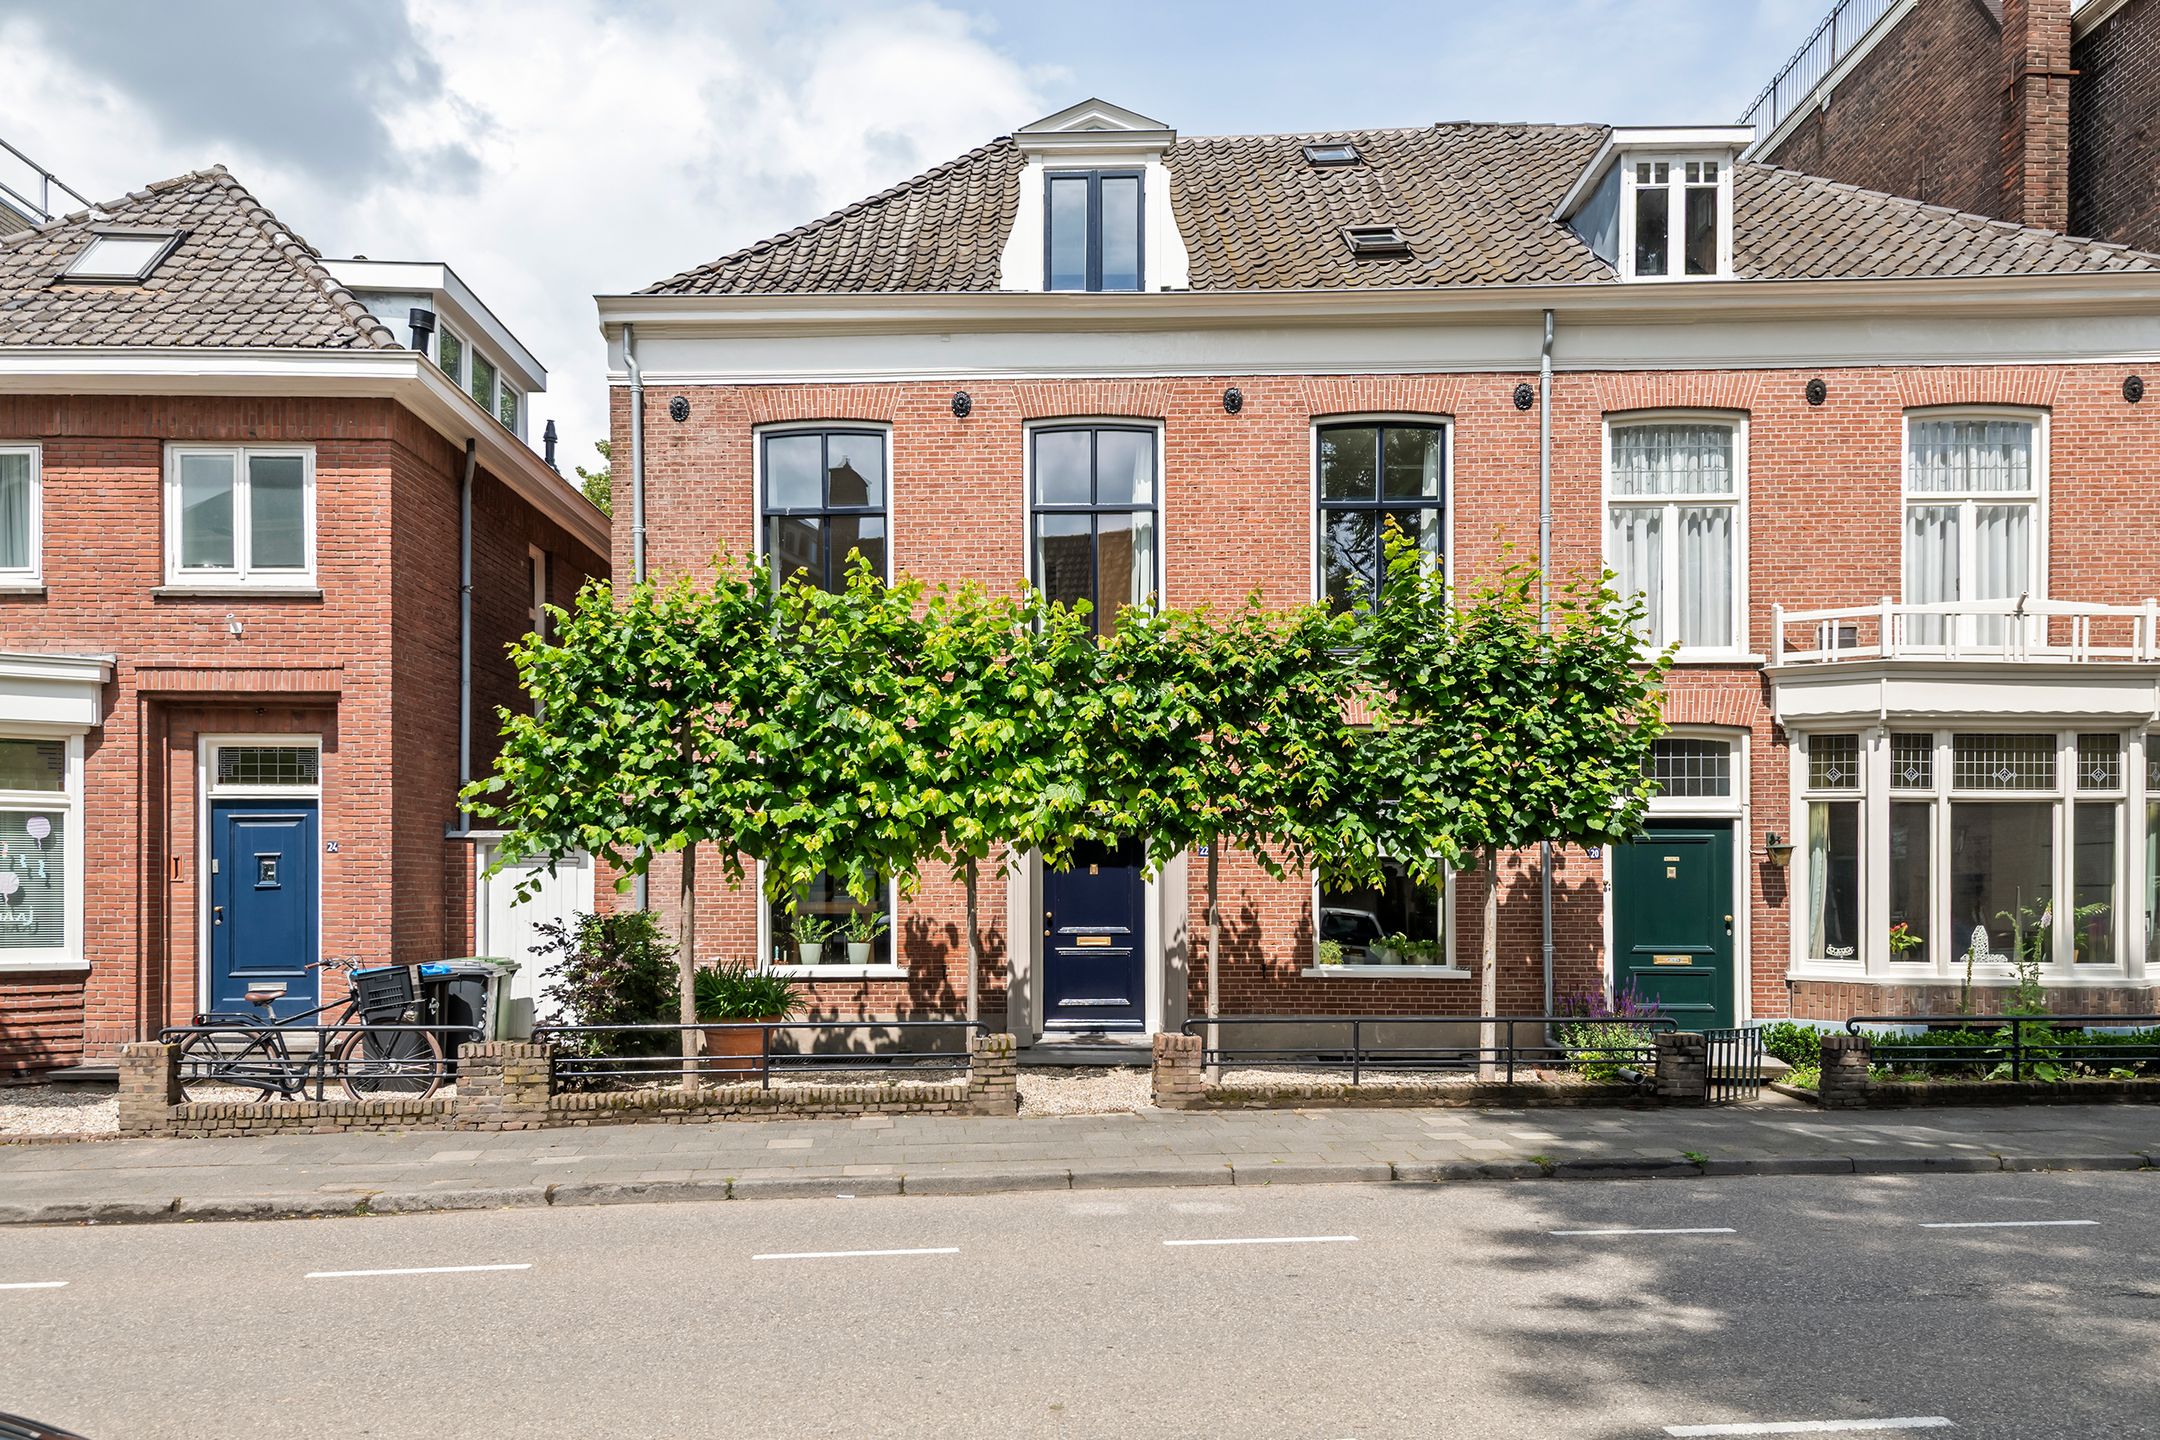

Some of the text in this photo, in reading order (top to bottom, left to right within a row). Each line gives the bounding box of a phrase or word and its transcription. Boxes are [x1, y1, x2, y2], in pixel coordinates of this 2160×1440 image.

[327, 842, 338, 852] 24
[1199, 846, 1209, 855] 22
[1590, 849, 1600, 859] 20
